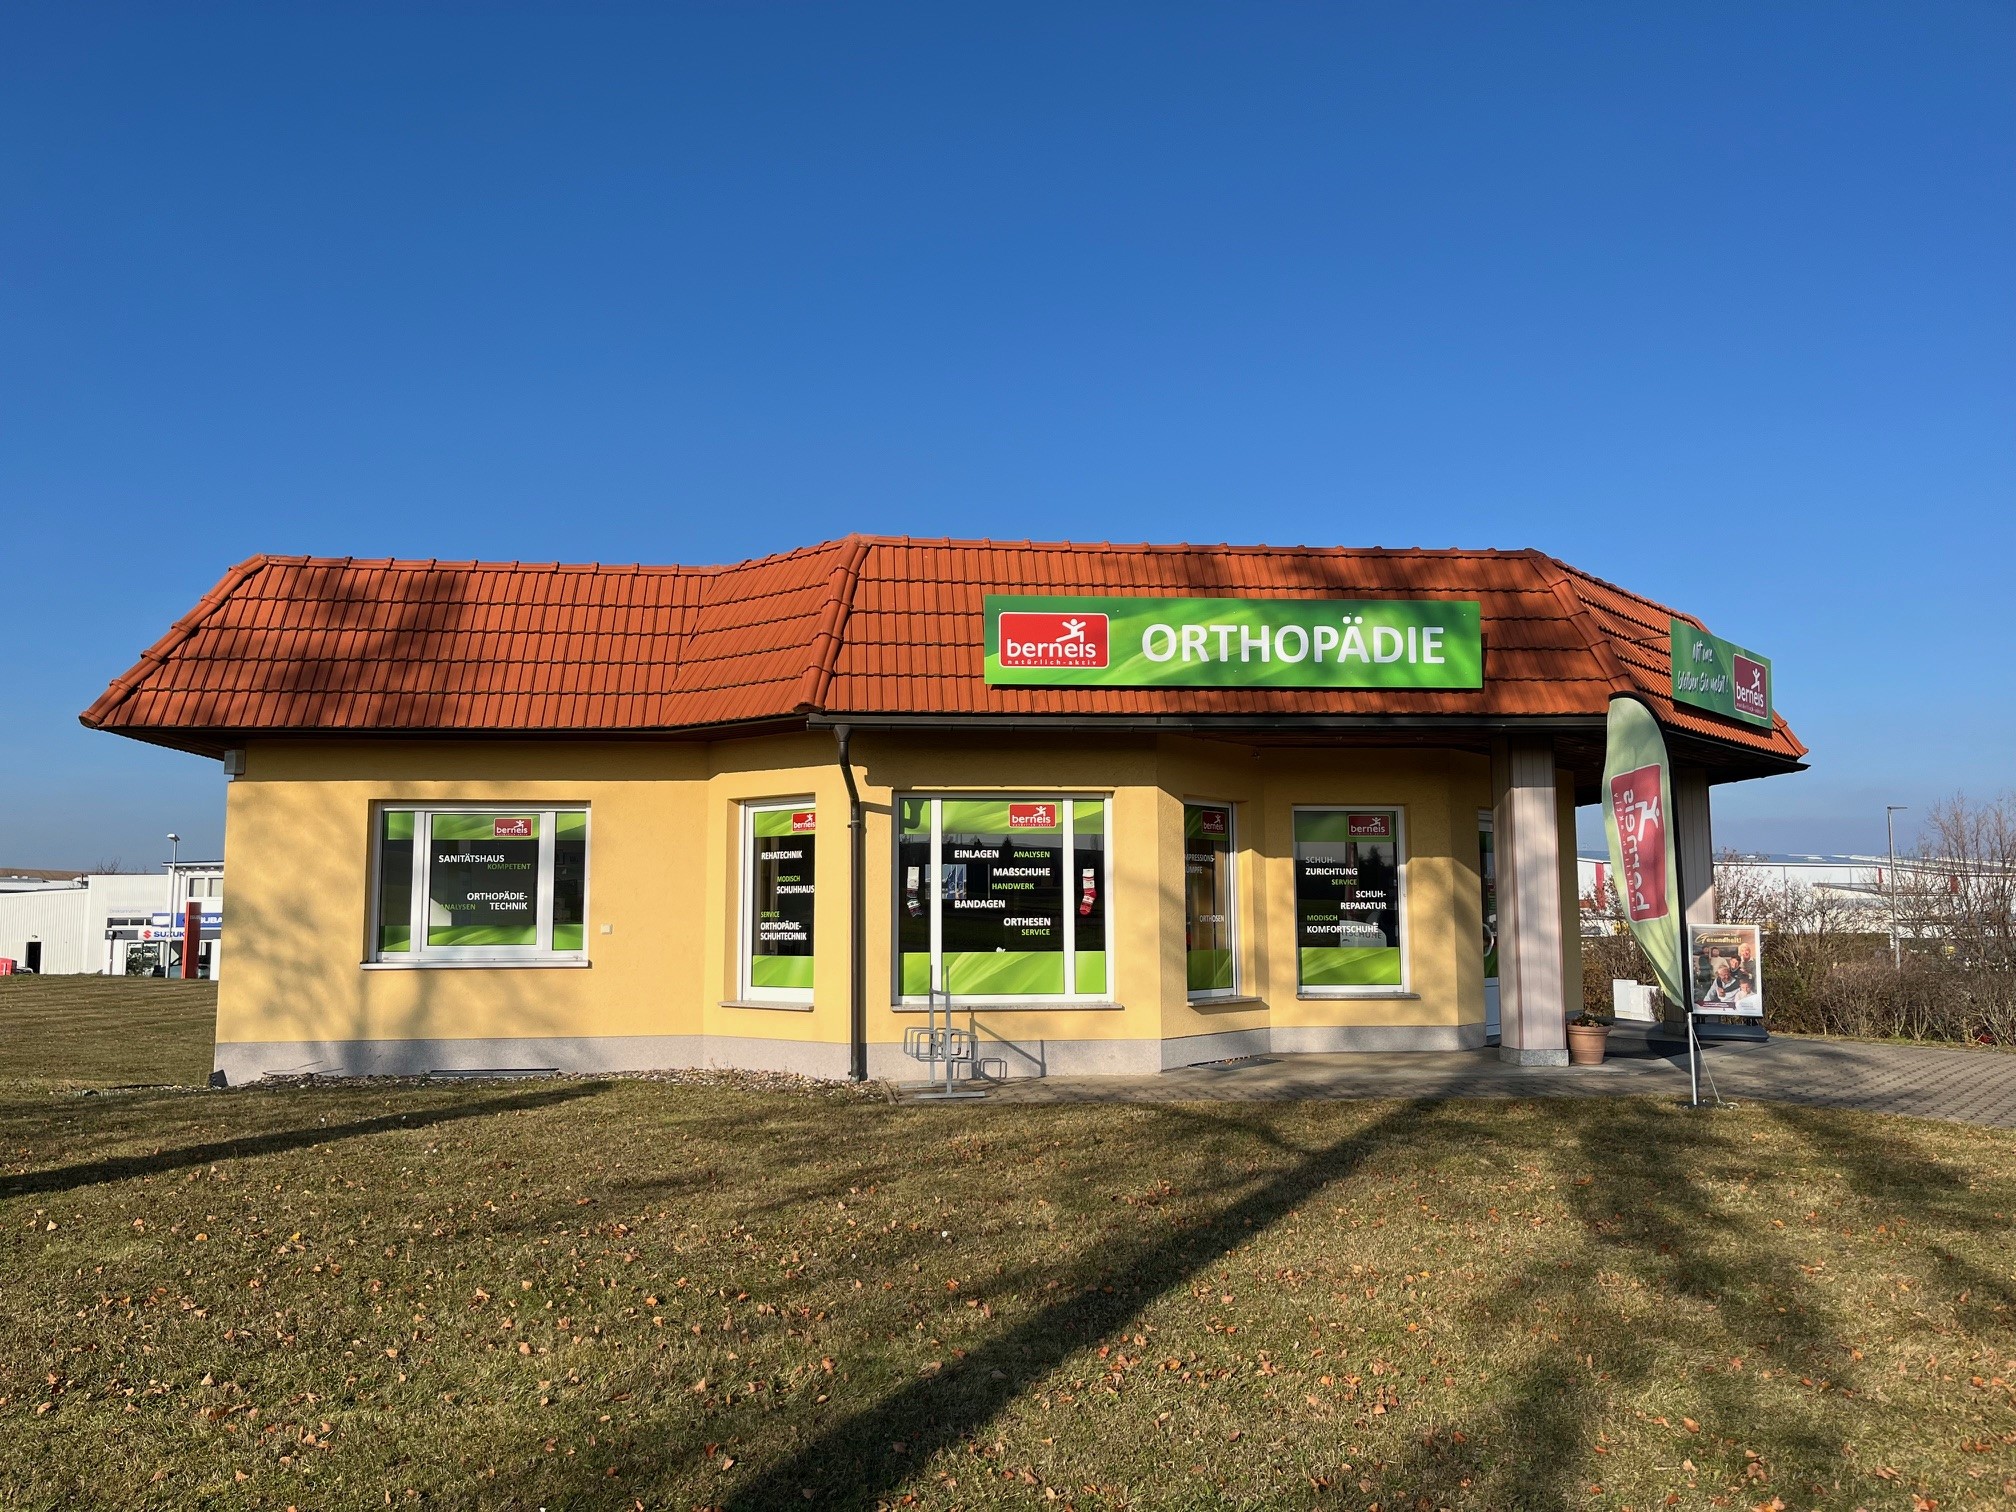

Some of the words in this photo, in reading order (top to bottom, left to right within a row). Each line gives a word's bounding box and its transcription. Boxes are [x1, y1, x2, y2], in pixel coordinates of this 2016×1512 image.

[1142, 616, 1445, 664] ORTHOPÄDIE
[1007, 638, 1096, 658] berneis
[1736, 681, 1764, 707] berneis
[1012, 815, 1051, 824] berneis
[497, 826, 528, 834] berneis
[1203, 821, 1224, 831] berneis
[1350, 825, 1386, 833] berneis
[954, 850, 999, 859] EINLAGEN
[1623, 789, 1650, 911] berneis
[438, 853, 505, 863] SANITÄTSHAUS
[761, 850, 802, 860] REHATECHNIK
[1305, 856, 1336, 864] SCHUH-
[1305, 867, 1358, 876] ZURICHTUNG
[776, 875, 801, 883] MODISCH
[776, 885, 815, 895] SCHUHHAUS
[991, 882, 1035, 890] HANDWERK
[467, 891, 528, 901] ORTHOPÄDIE-
[1355, 890, 1387, 898] SCHUH-
[489, 902, 528, 911] TECHNIK
[954, 900, 1006, 909] BANDAGEN
[1340, 902, 1387, 910] REPARATUR
[760, 920, 802, 930] ORTHOPÄDIE-
[1003, 917, 1051, 926] ORTHESEN
[1021, 928, 1050, 936] SERVICE
[1306, 925, 1379, 933] KOMFORTSCHUHE
[760, 931, 807, 941] SCHUHTECHNIK
